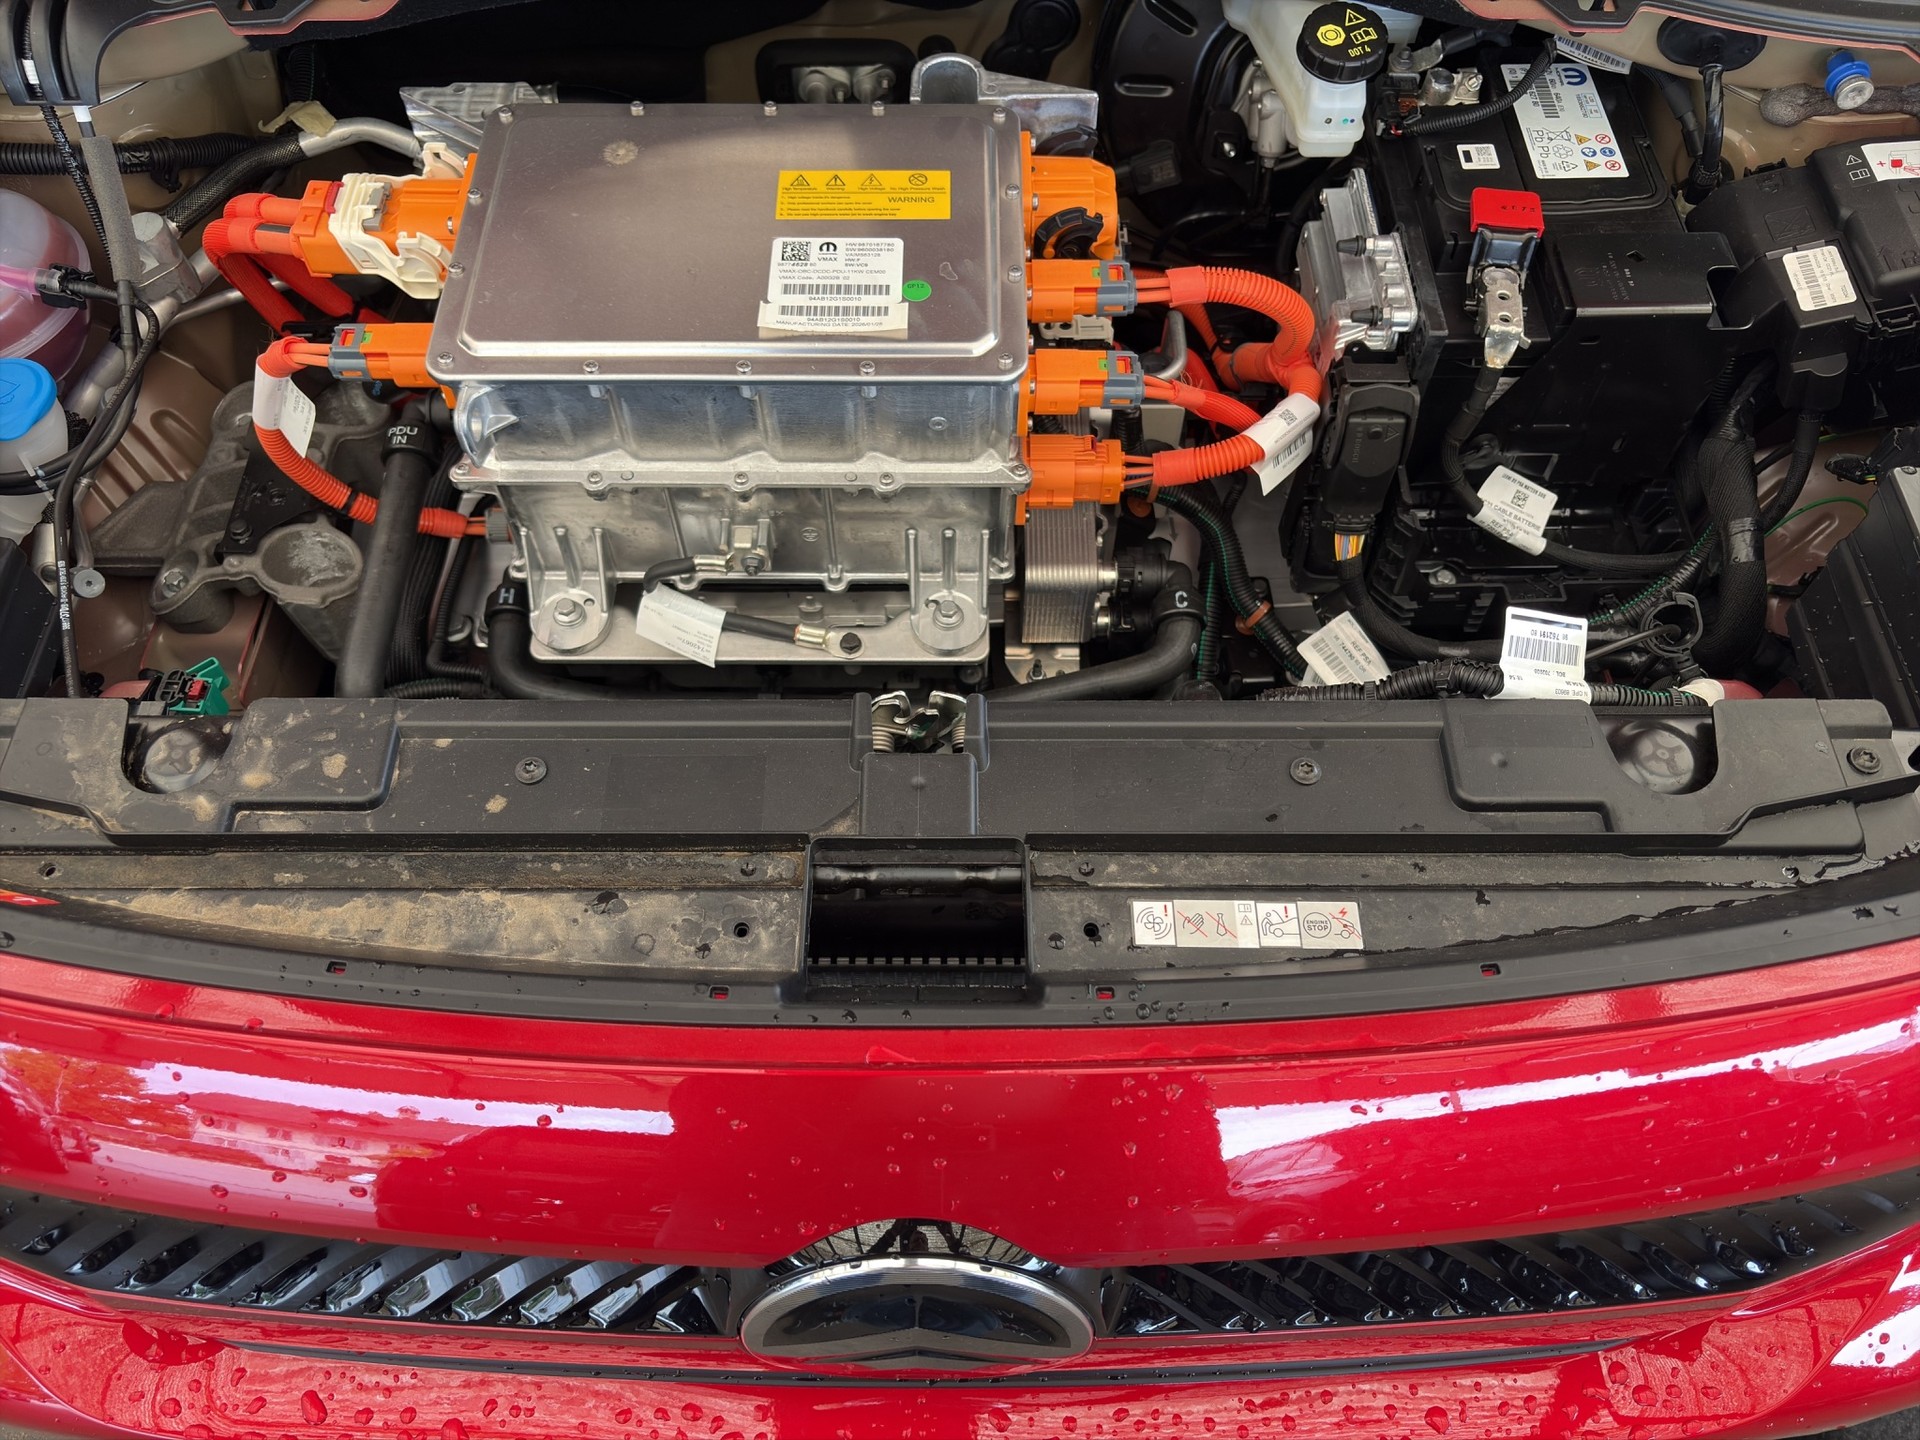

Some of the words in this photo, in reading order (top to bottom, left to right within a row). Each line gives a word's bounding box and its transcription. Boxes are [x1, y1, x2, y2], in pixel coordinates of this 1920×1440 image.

[1348, 46, 1364, 57] DOT
[1365, 45, 1372, 53] 4
[1533, 130, 1545, 143] Pb
[1538, 145, 1551, 159] Pb
[888, 196, 935, 204] WARNING
[388, 426, 418, 437] PDU
[392, 435, 408, 444] IN
[1493, 503, 1514, 517] CABLE
[499, 587, 516, 604] H
[1175, 590, 1189, 608] C
